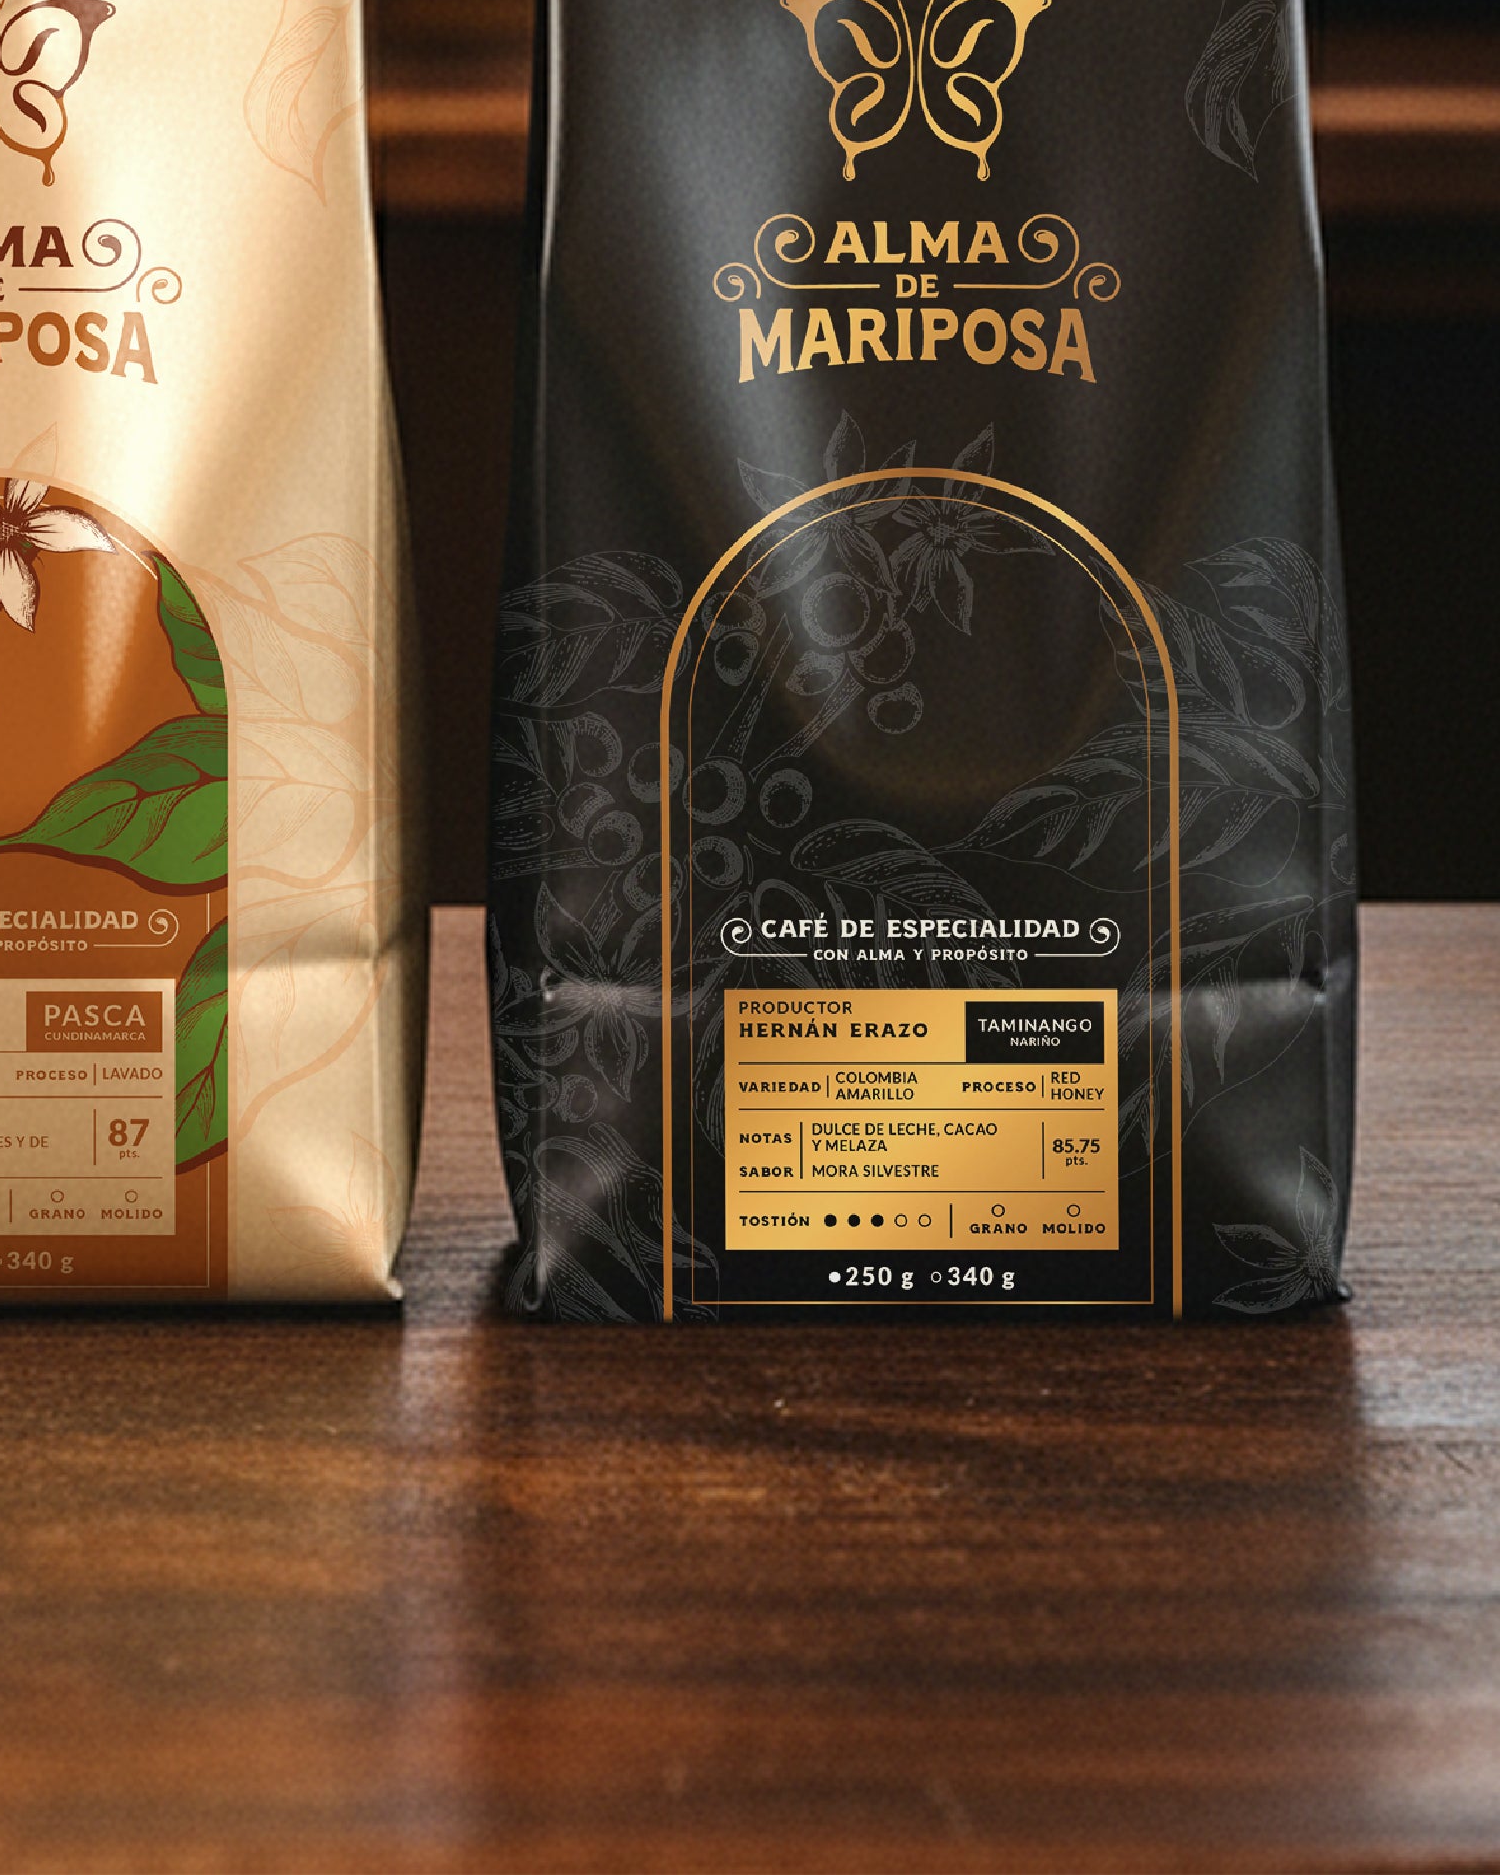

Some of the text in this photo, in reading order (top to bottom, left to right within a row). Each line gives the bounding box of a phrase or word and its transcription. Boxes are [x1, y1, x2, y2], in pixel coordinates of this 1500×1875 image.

[824, 220, 1010, 264] ALMA
[895, 273, 940, 299] DE
[738, 307, 1098, 384] MARIPOSA
[761, 912, 1080, 939] CAFÉ DE ESPECIALIDAD
[813, 944, 1029, 962] CON ALMA Y PROPÓSITO
[738, 1000, 853, 1015] PRODUCTOR
[44, 1004, 147, 1027] PASCA
[739, 1018, 929, 1038] HERNÁN ERAZO
[977, 1018, 1093, 1034] TAMINANGO
[44, 1031, 147, 1042] CUNDINAMARCA
[1010, 1035, 1061, 1047] NARIÑO
[16, 1069, 88, 1081] PROCESO
[102, 1067, 163, 1081] LAVADO
[835, 1070, 918, 1085] COLOMBIA
[1050, 1071, 1082, 1085] RED
[738, 1081, 822, 1093] VARIEDAD
[835, 1087, 915, 1101] AMARILLO
[961, 1081, 1037, 1093] PROCESO
[1050, 1087, 1105, 1101] HONEY
[107, 1118, 151, 1147] 87
[811, 1122, 998, 1139] DULCE DE LECHE, CACAO
[15, 1135, 26, 1149] Y
[29, 1135, 50, 1149] DE
[739, 1132, 793, 1145] NOTAS
[811, 1139, 888, 1153] Y MELAZA
[1051, 1138, 1101, 1155] 85.75
[118, 1148, 140, 1161] pts.
[1065, 1155, 1088, 1169] pts.
[739, 1165, 794, 1178] SABOR
[811, 1164, 940, 1178] MORA SILVESTRE
[28, 1208, 86, 1221] GRANO
[100, 1208, 163, 1221] MOLIDO
[739, 1212, 810, 1228] TOSTIÓN
[969, 1222, 1028, 1235] GRANO
[1042, 1222, 1106, 1235] MOLIDO
[6, 1251, 53, 1271] 340
[60, 1254, 75, 1275] g
[845, 1266, 1016, 1290] 250 g 340 g
